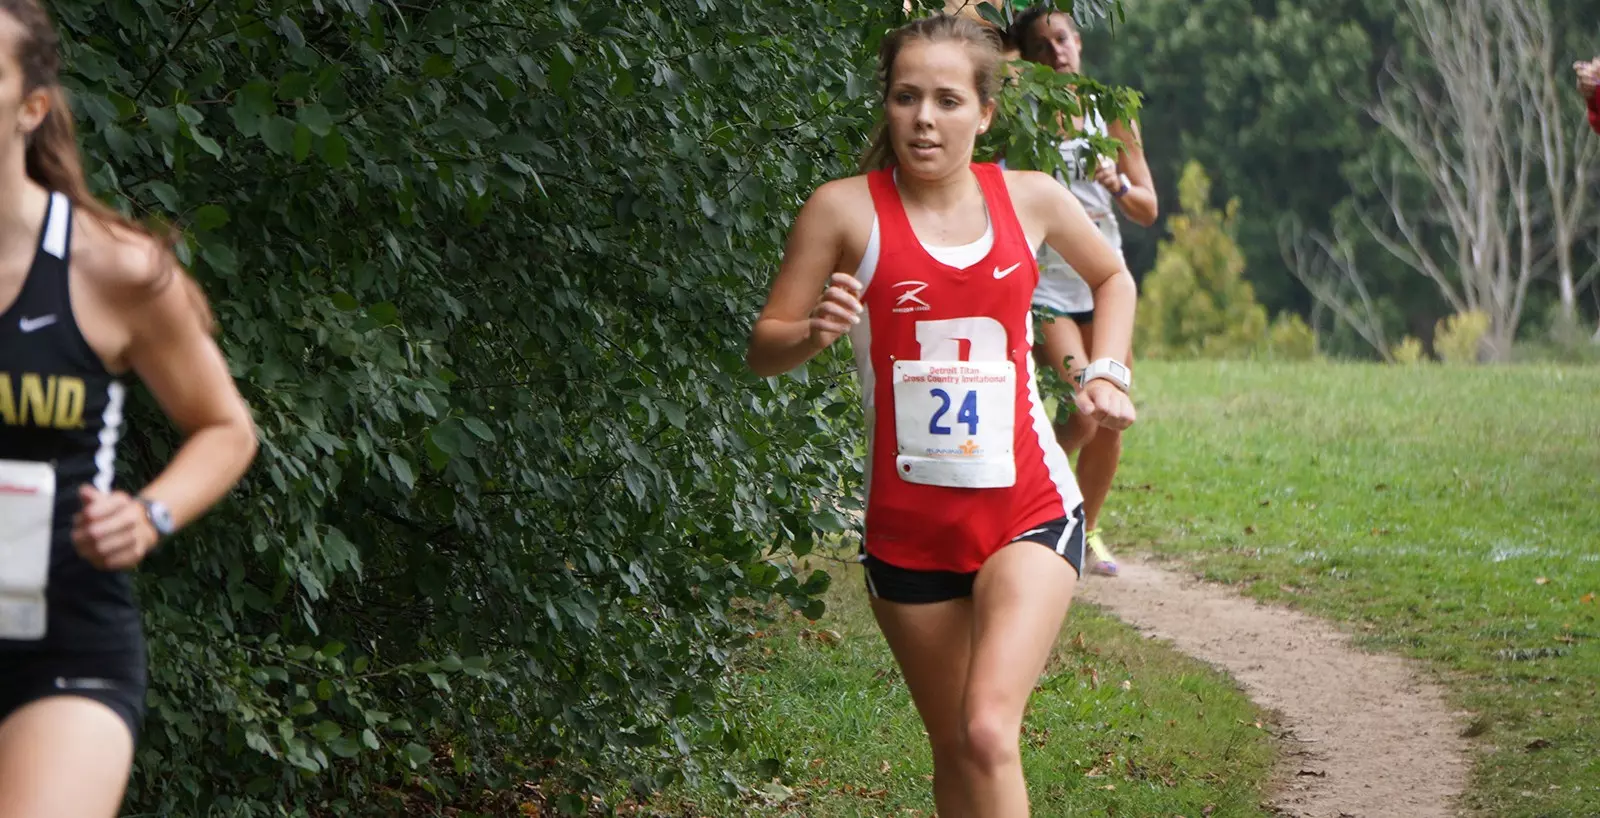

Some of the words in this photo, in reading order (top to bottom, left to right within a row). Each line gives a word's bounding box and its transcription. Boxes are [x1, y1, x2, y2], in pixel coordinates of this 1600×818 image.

[929, 366, 957, 375] Detroit
[960, 366, 980, 375] Titan
[902, 374, 925, 383] Cross
[927, 374, 959, 384] Country
[961, 374, 1006, 384] Invitational
[928, 388, 979, 435] 24
